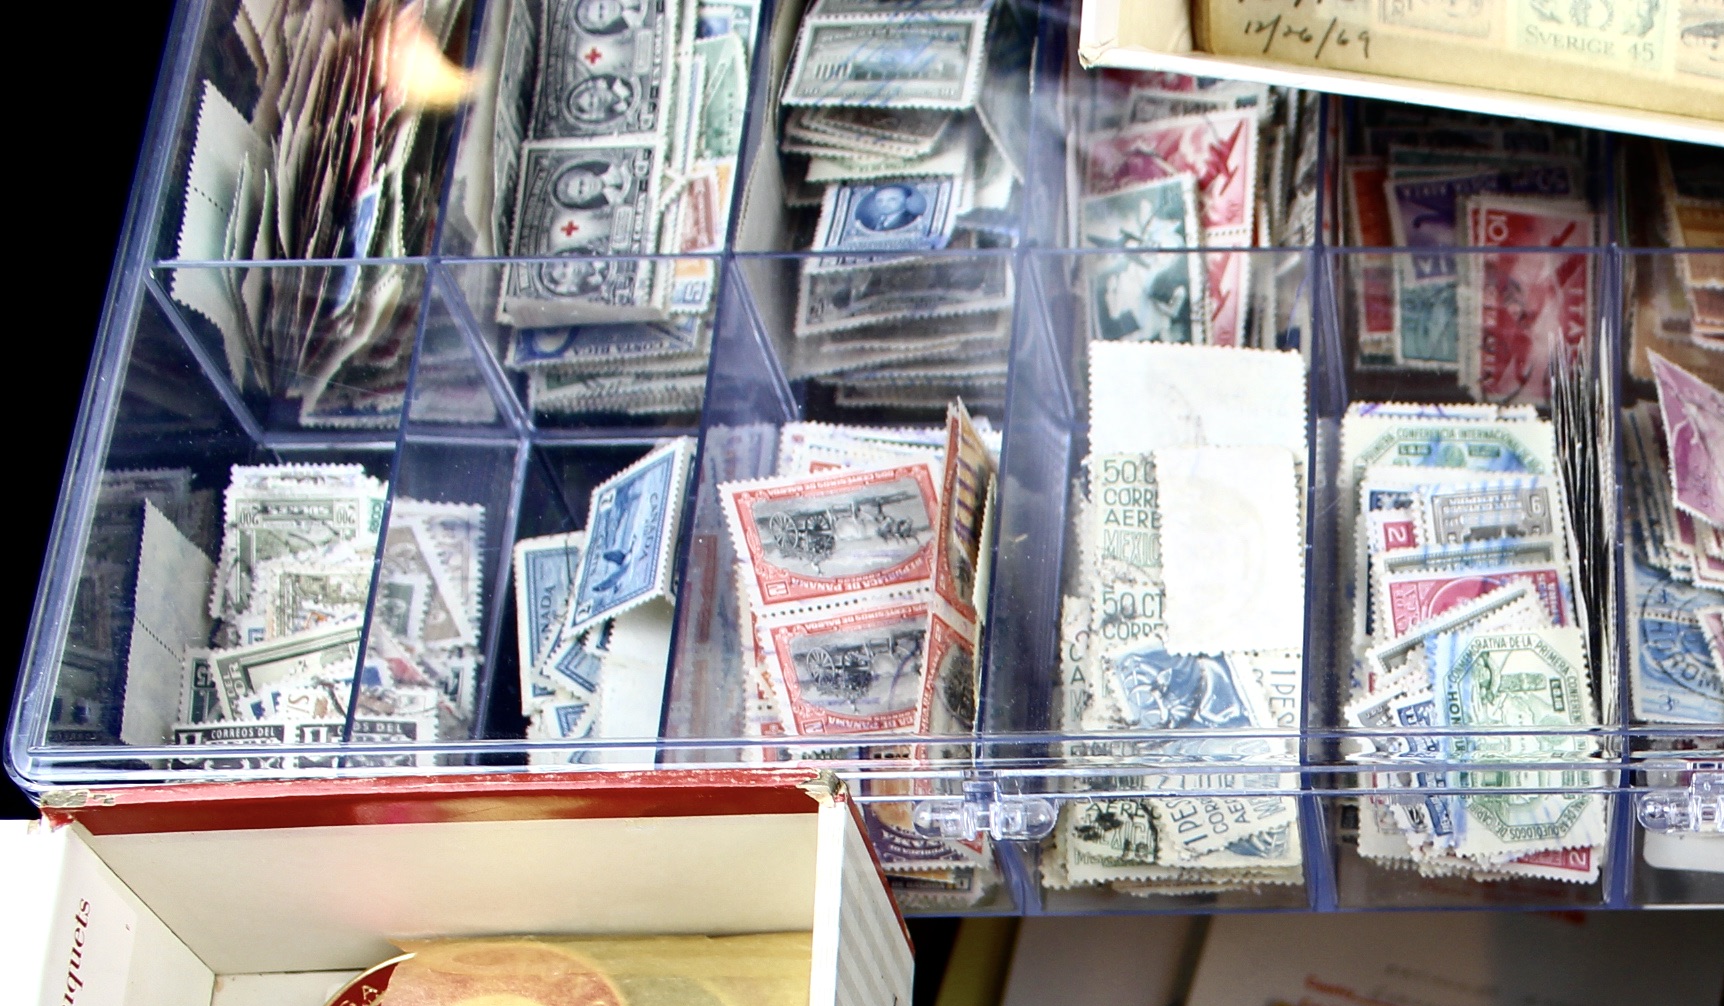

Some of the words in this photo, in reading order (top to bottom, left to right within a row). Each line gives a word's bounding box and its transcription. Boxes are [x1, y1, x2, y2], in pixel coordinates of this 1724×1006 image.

[1524, 24, 1615, 56] SVERIGE
[1628, 41, 1656, 62] 45
[1103, 459, 1137, 484] 50
[211, 727, 254, 739] CORREOS
[256, 727, 275, 737] DEL
